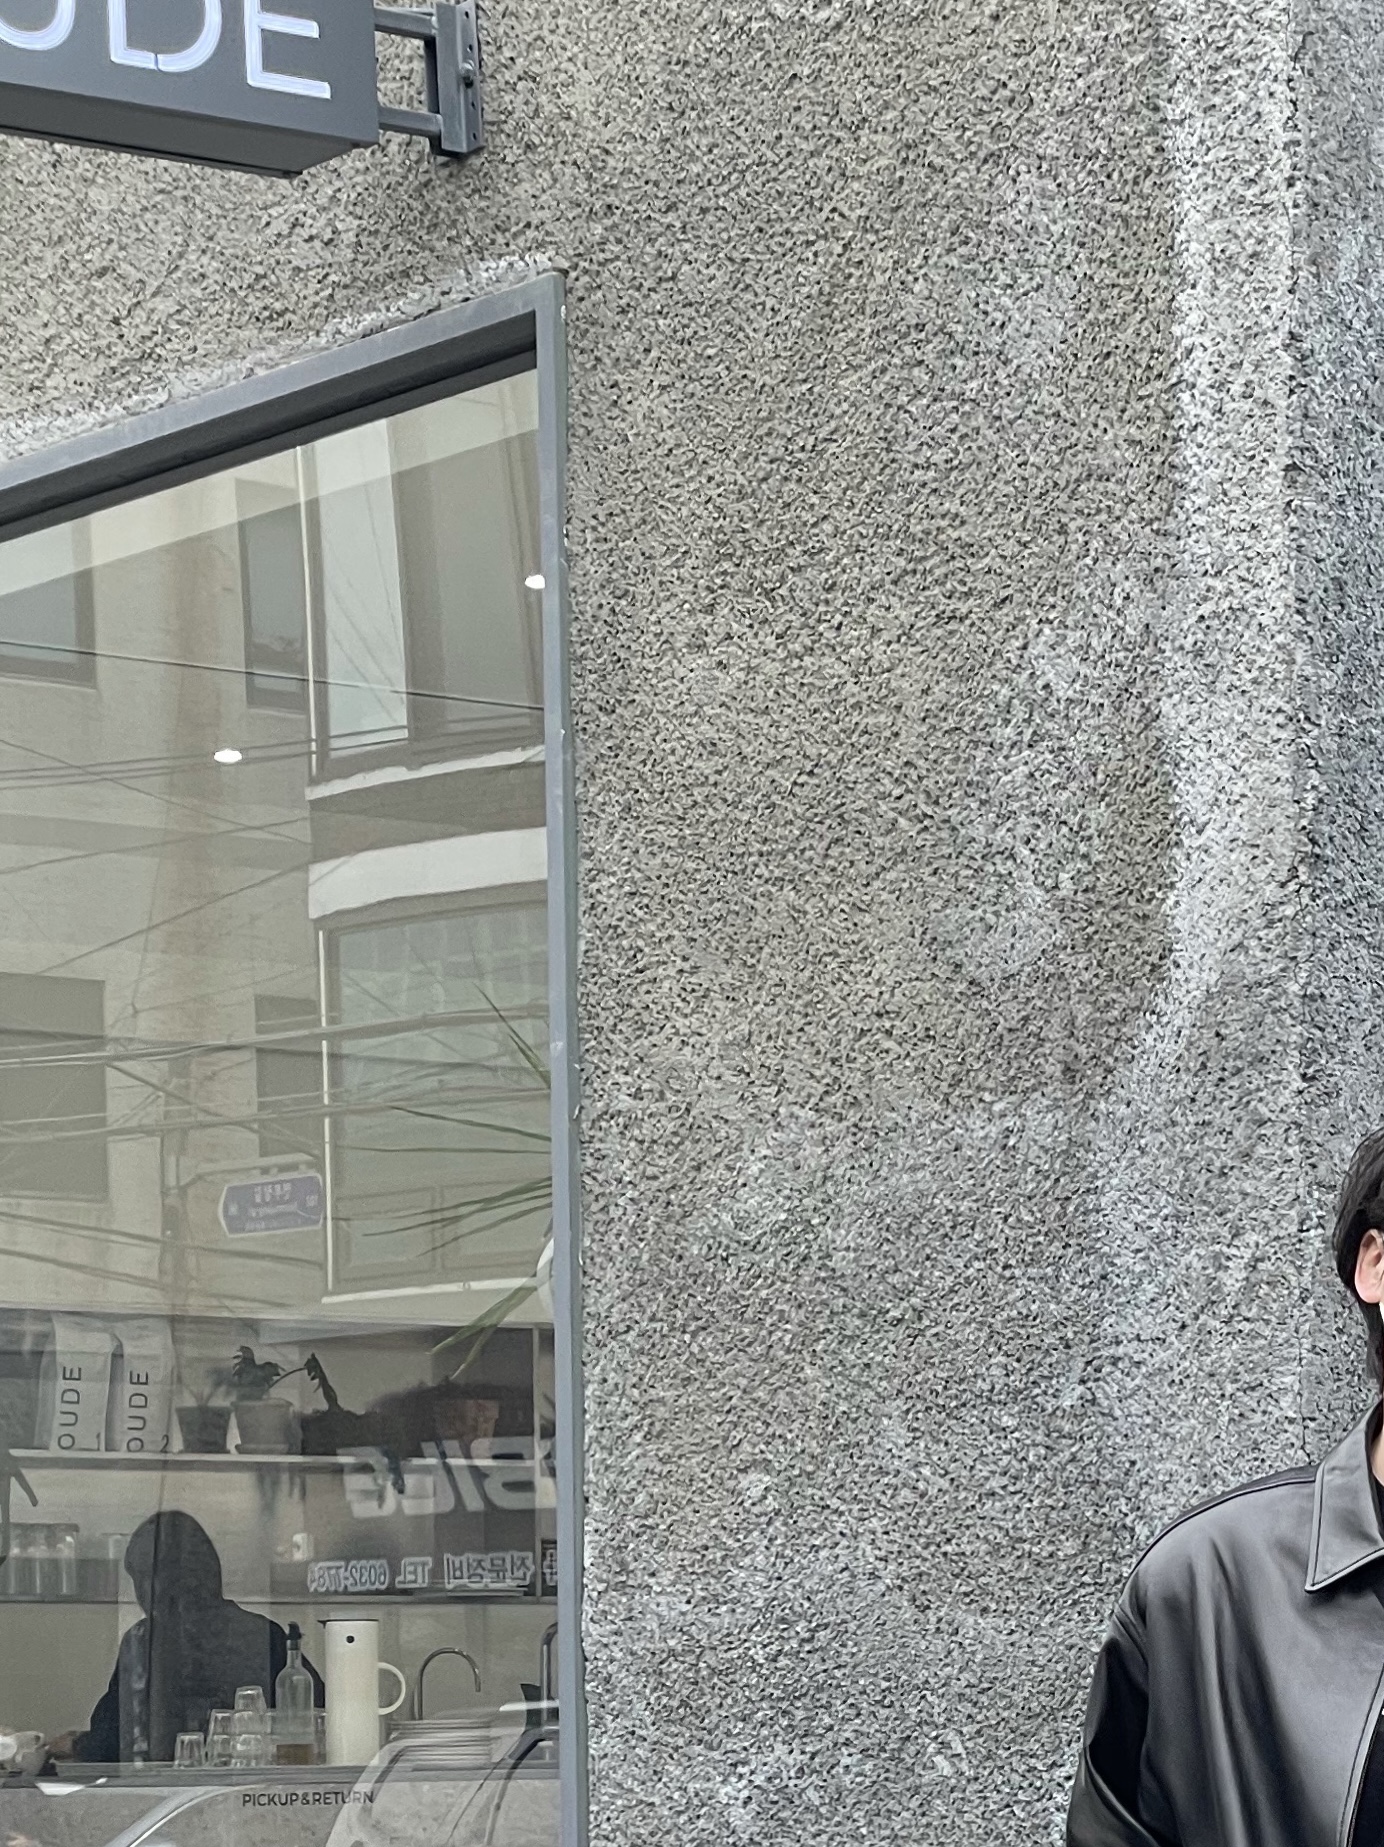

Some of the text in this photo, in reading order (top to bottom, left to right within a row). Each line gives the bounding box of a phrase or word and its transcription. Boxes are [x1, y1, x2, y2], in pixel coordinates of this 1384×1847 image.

[58, 1366, 82, 1450] OUDE
[126, 1370, 149, 1452] OUDE
[159, 1434, 170, 1453] 2
[242, 1790, 374, 1807] PICKUP&RETURN
